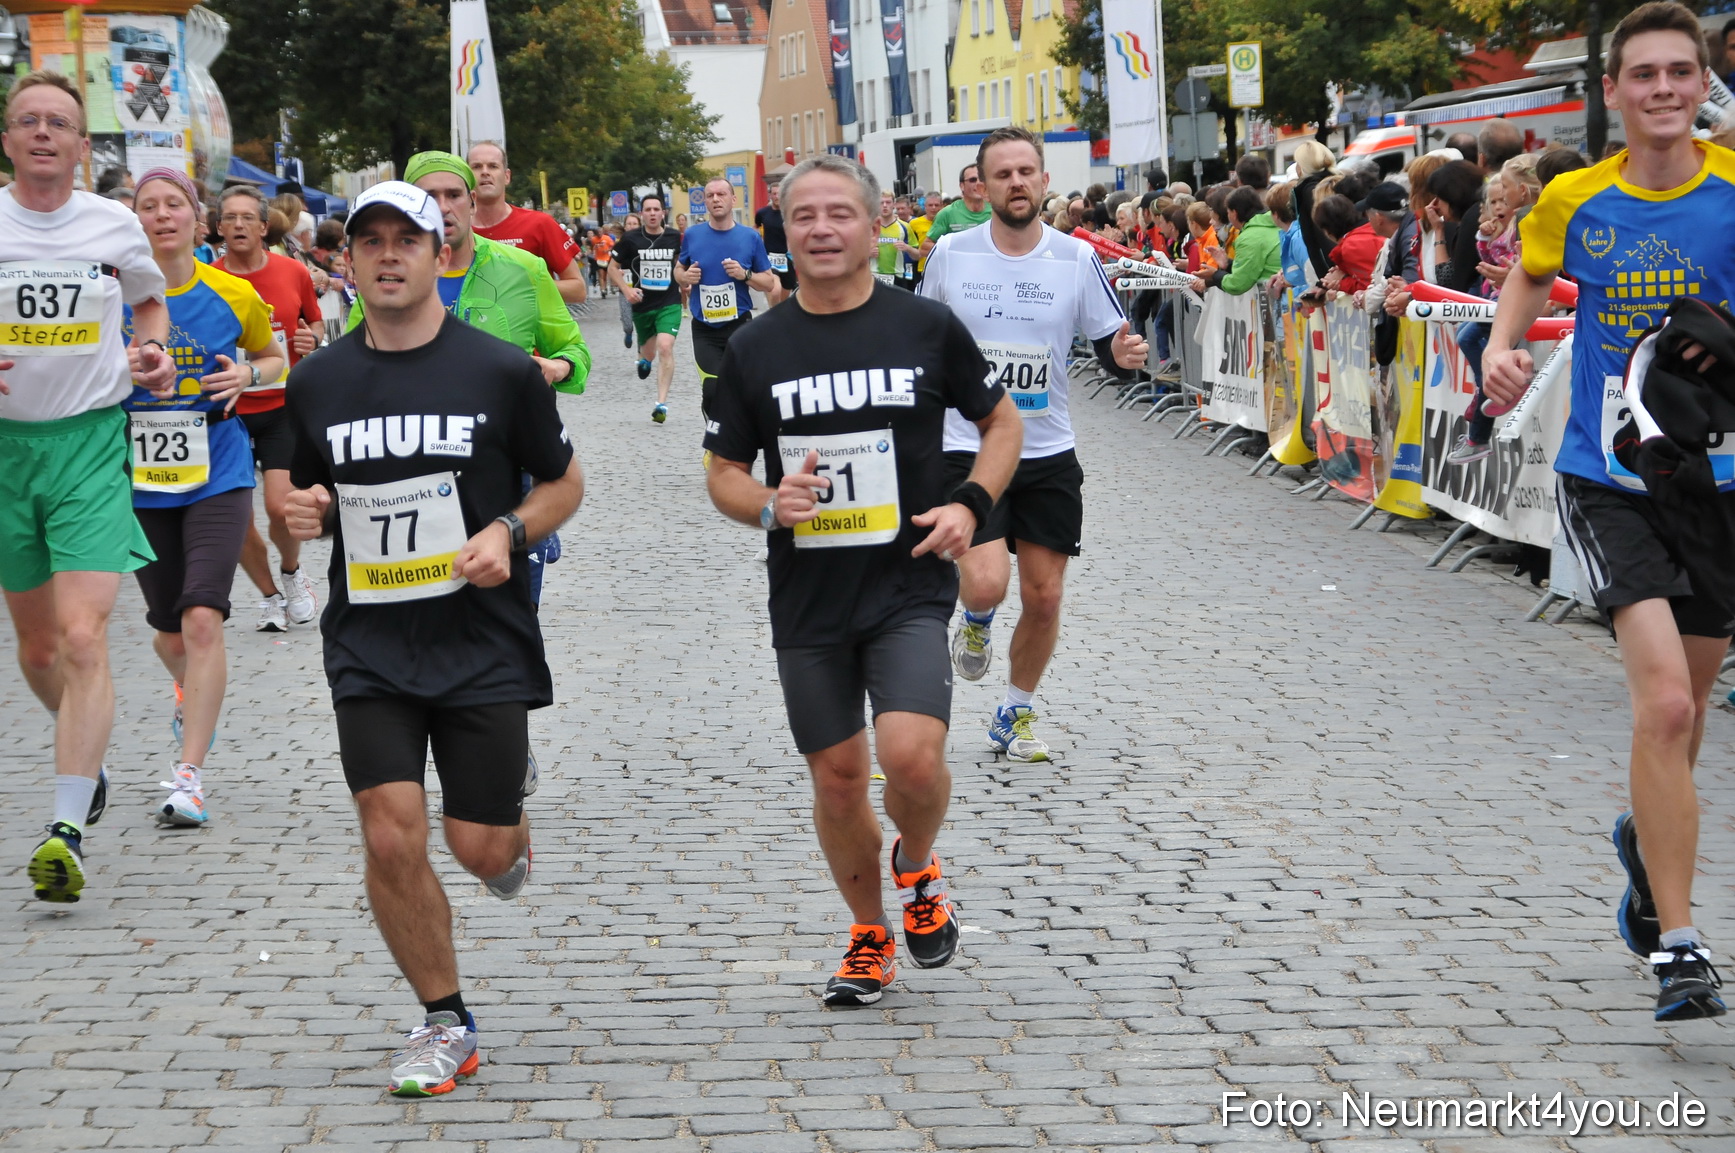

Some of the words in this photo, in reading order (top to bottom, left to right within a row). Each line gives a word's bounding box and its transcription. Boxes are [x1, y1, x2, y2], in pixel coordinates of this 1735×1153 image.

[573, 196, 583, 211] D
[690, 205, 705, 215] TAXI
[637, 248, 674, 260] THULE
[0, 270, 29, 279] ARTL
[32, 269, 84, 278] Neumarkt
[643, 267, 668, 279] 2151
[1137, 264, 1159, 276] BMW
[962, 282, 1003, 292] PEUGEOT
[1014, 282, 1041, 291] HECK
[17, 284, 82, 319] 637
[705, 293, 730, 309] 298
[964, 292, 999, 301] MÜLLER
[1017, 290, 1055, 300] DESIGN
[1442, 304, 1482, 318] BMW
[1608, 301, 1674, 316] 21.Septembe
[8, 325, 88, 347] Stefan
[1006, 350, 1045, 360] Neumarkt
[771, 368, 915, 420] THULE
[877, 394, 910, 402] SWEDEN
[146, 419, 190, 428] Neumarkt
[134, 431, 189, 462] 123
[326, 414, 475, 466] THULE
[430, 442, 467, 452] SWEDEN
[817, 444, 872, 458] Neumarkt
[146, 471, 179, 482] Anika
[813, 461, 856, 504] 51
[340, 496, 370, 508] PARTL
[371, 488, 433, 508] Neumarkt
[811, 512, 867, 531] Oswald
[369, 508, 419, 556] 77
[366, 562, 448, 586] Waldemar
